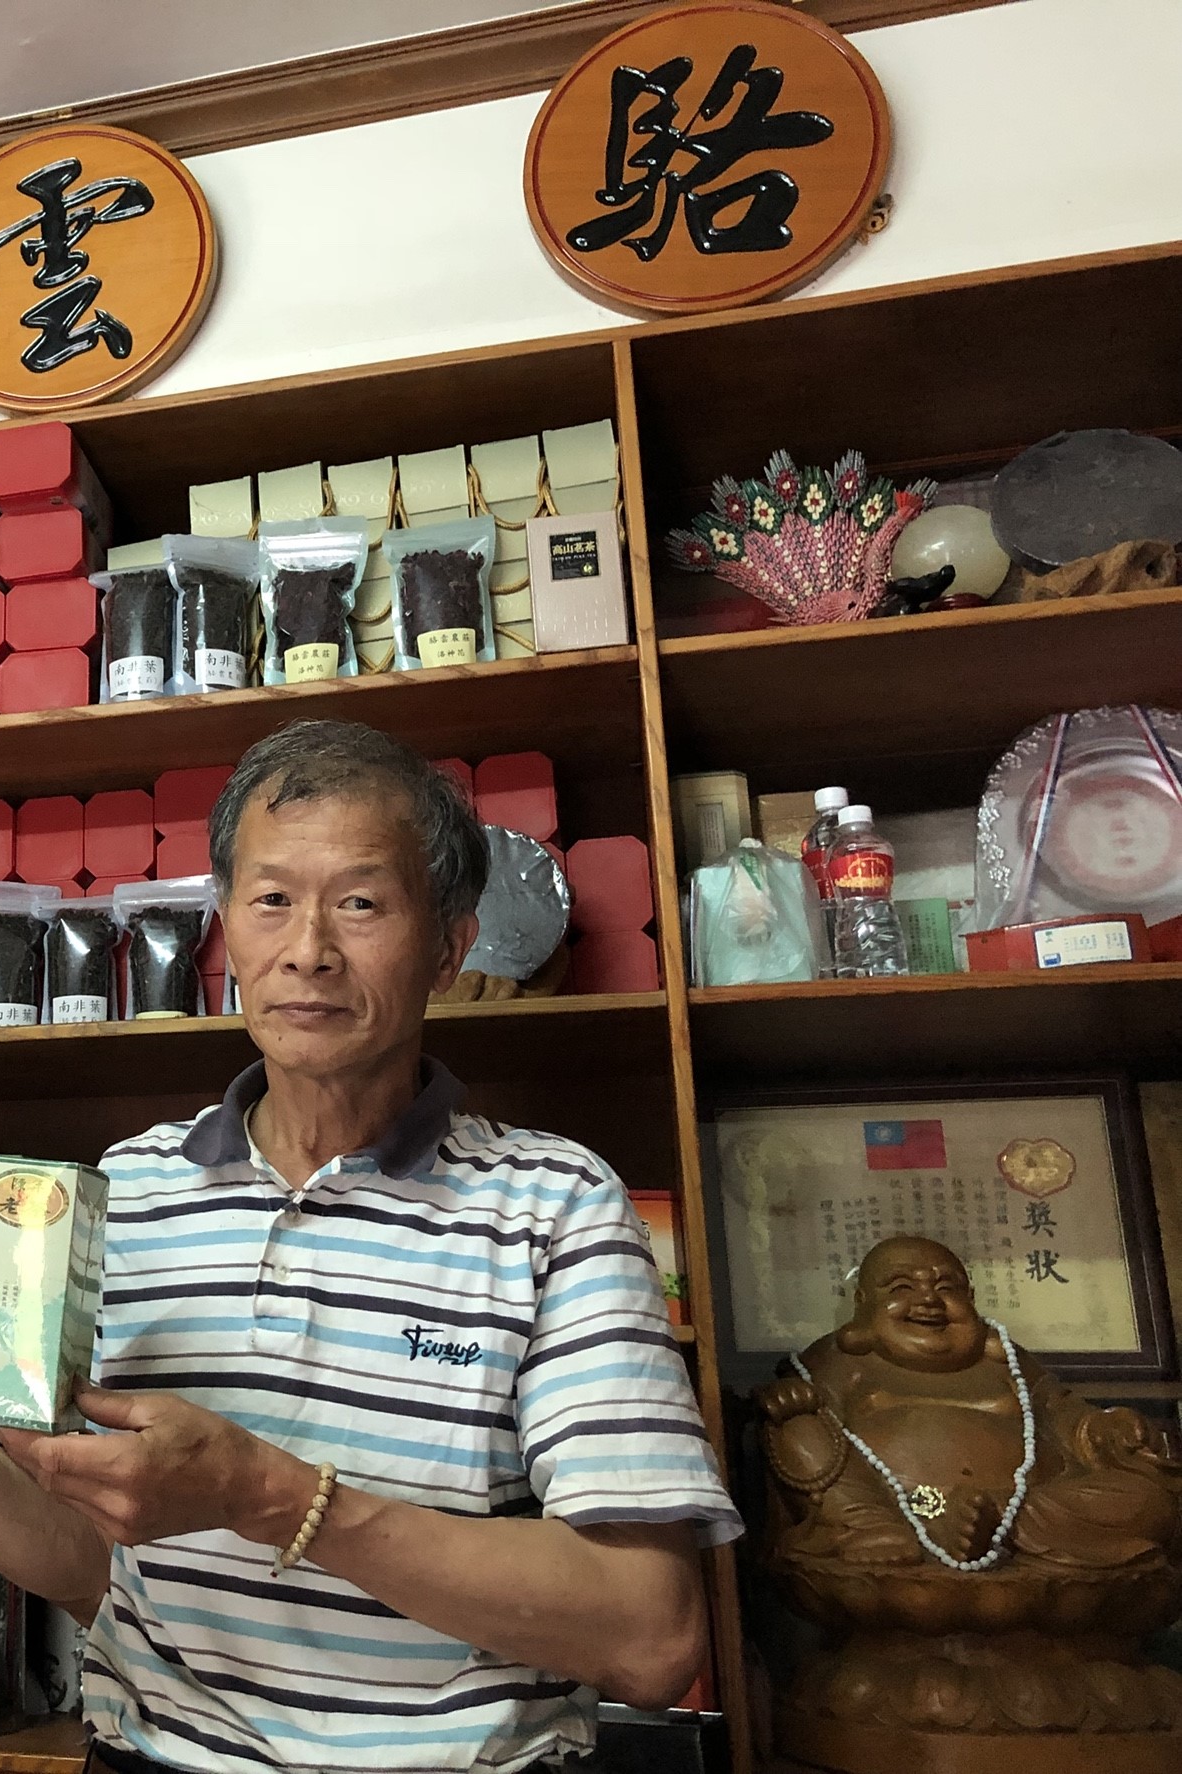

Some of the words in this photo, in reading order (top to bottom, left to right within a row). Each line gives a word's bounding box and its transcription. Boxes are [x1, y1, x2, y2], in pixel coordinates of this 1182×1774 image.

[566, 44, 834, 262] 駱
[58, 999, 102, 1014] 南非葉
[1021, 1200, 1070, 1284] 獎狀
